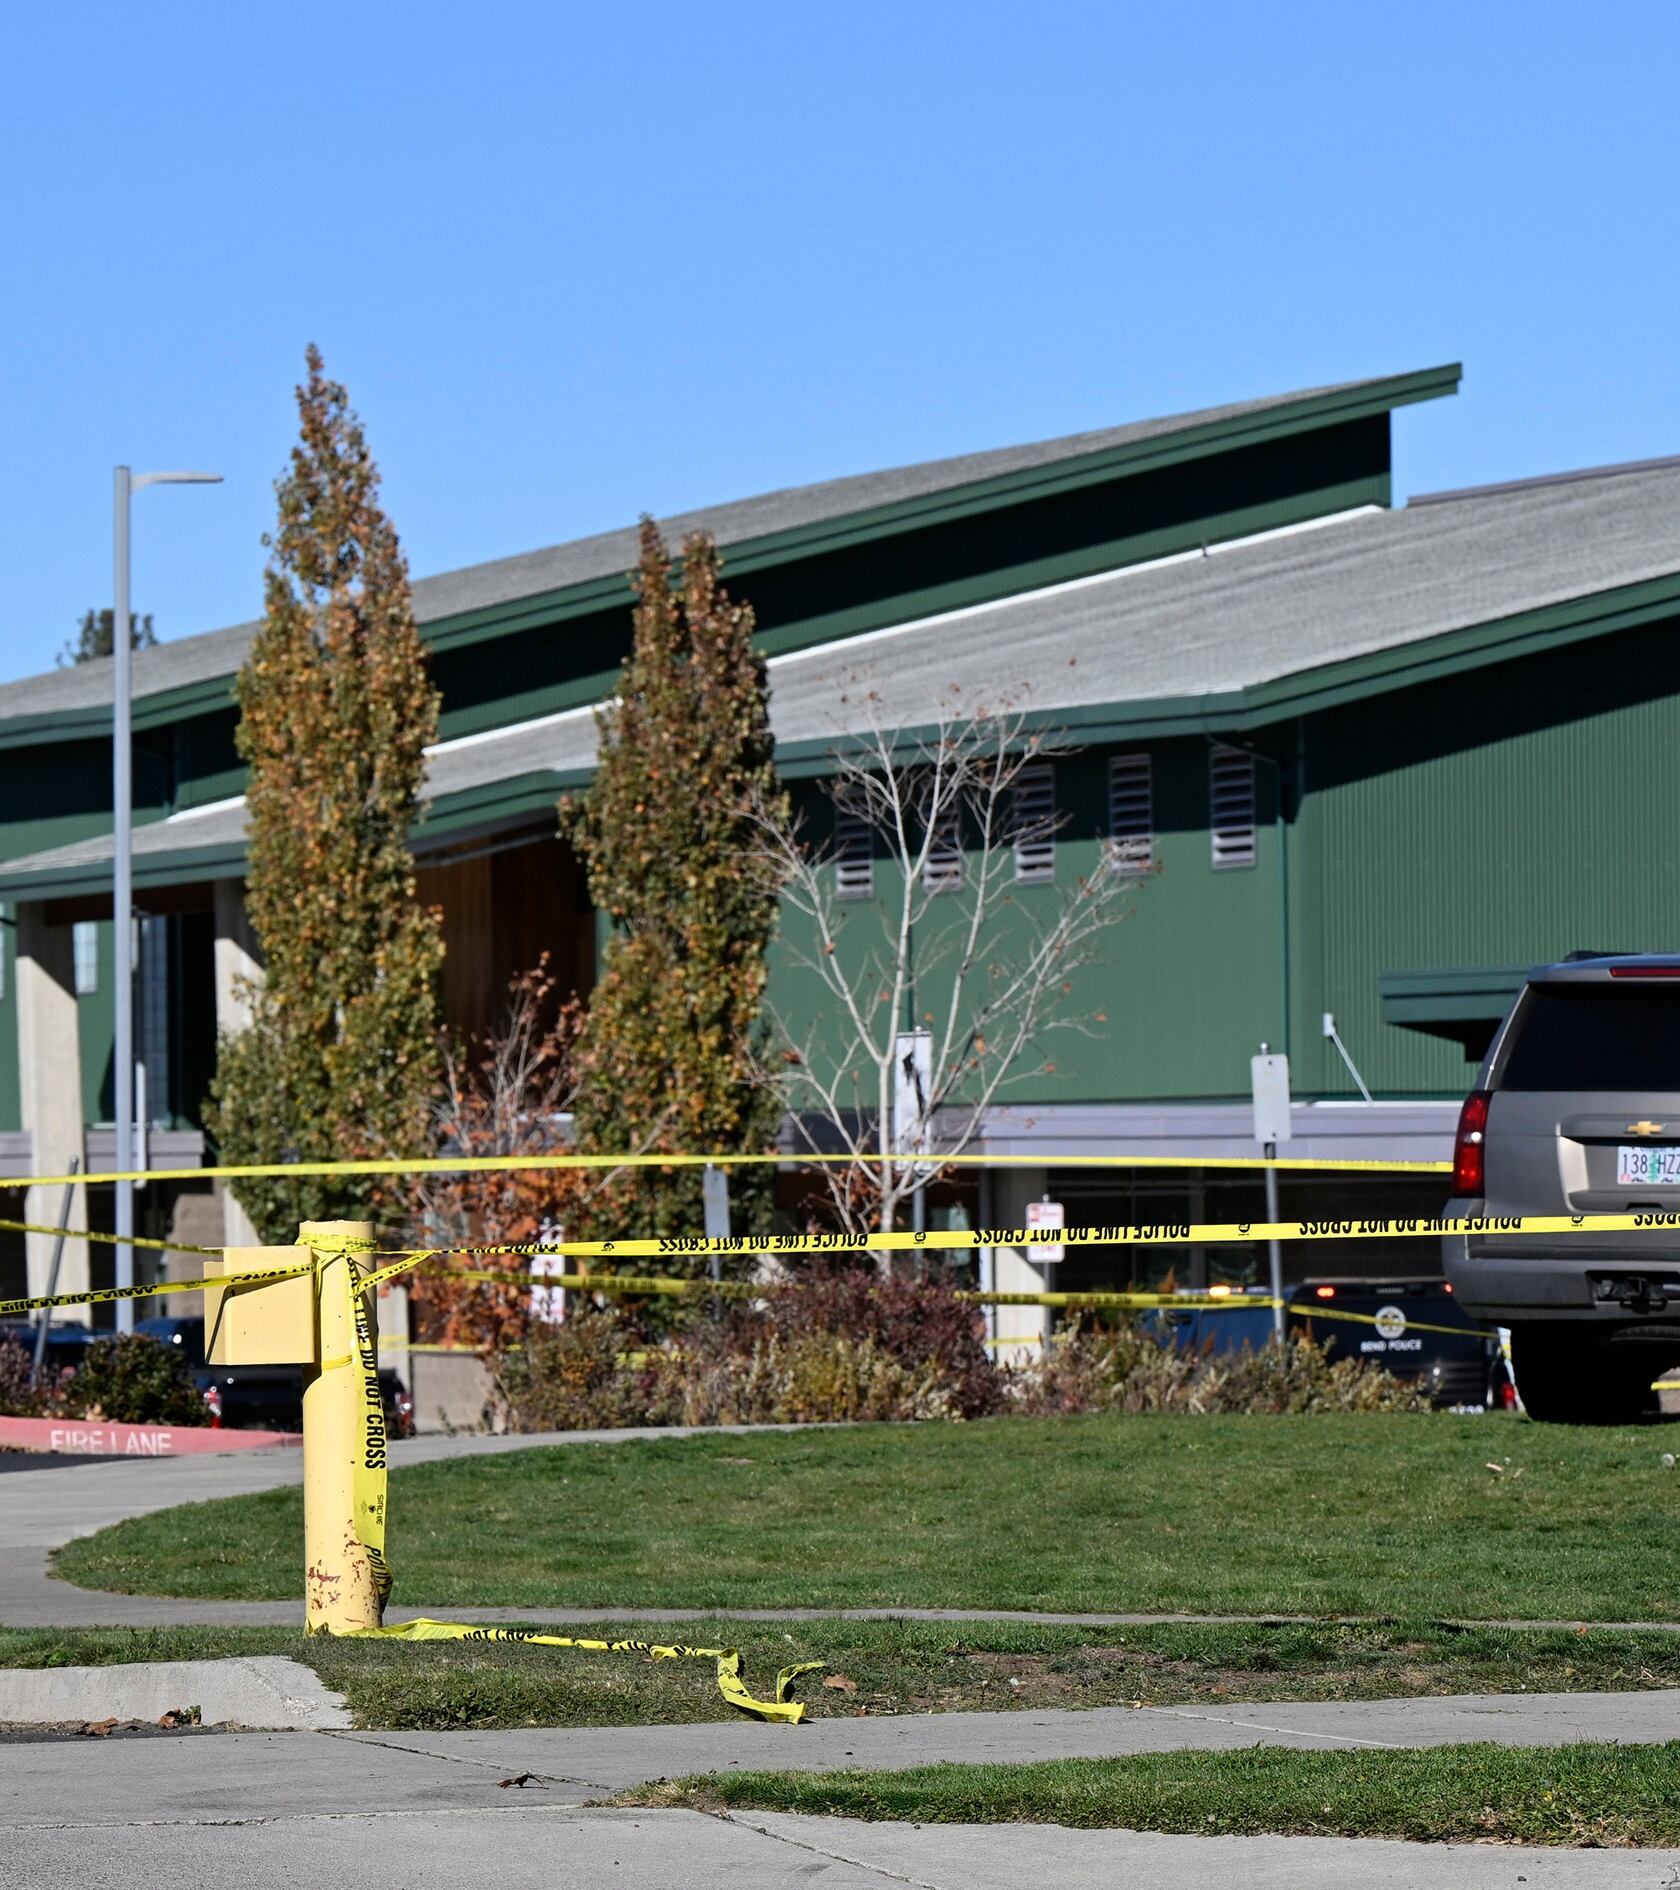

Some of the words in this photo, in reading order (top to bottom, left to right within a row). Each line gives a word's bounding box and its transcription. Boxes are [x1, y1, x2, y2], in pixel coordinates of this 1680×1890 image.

[1623, 1153, 1648, 1175] 138
[1387, 1339, 1422, 1351] POLICE
[364, 1376, 382, 1409] NOT
[50, 1429, 103, 1454] FIRE
[110, 1431, 172, 1456] LANE
[365, 1413, 387, 1470] CROSS
